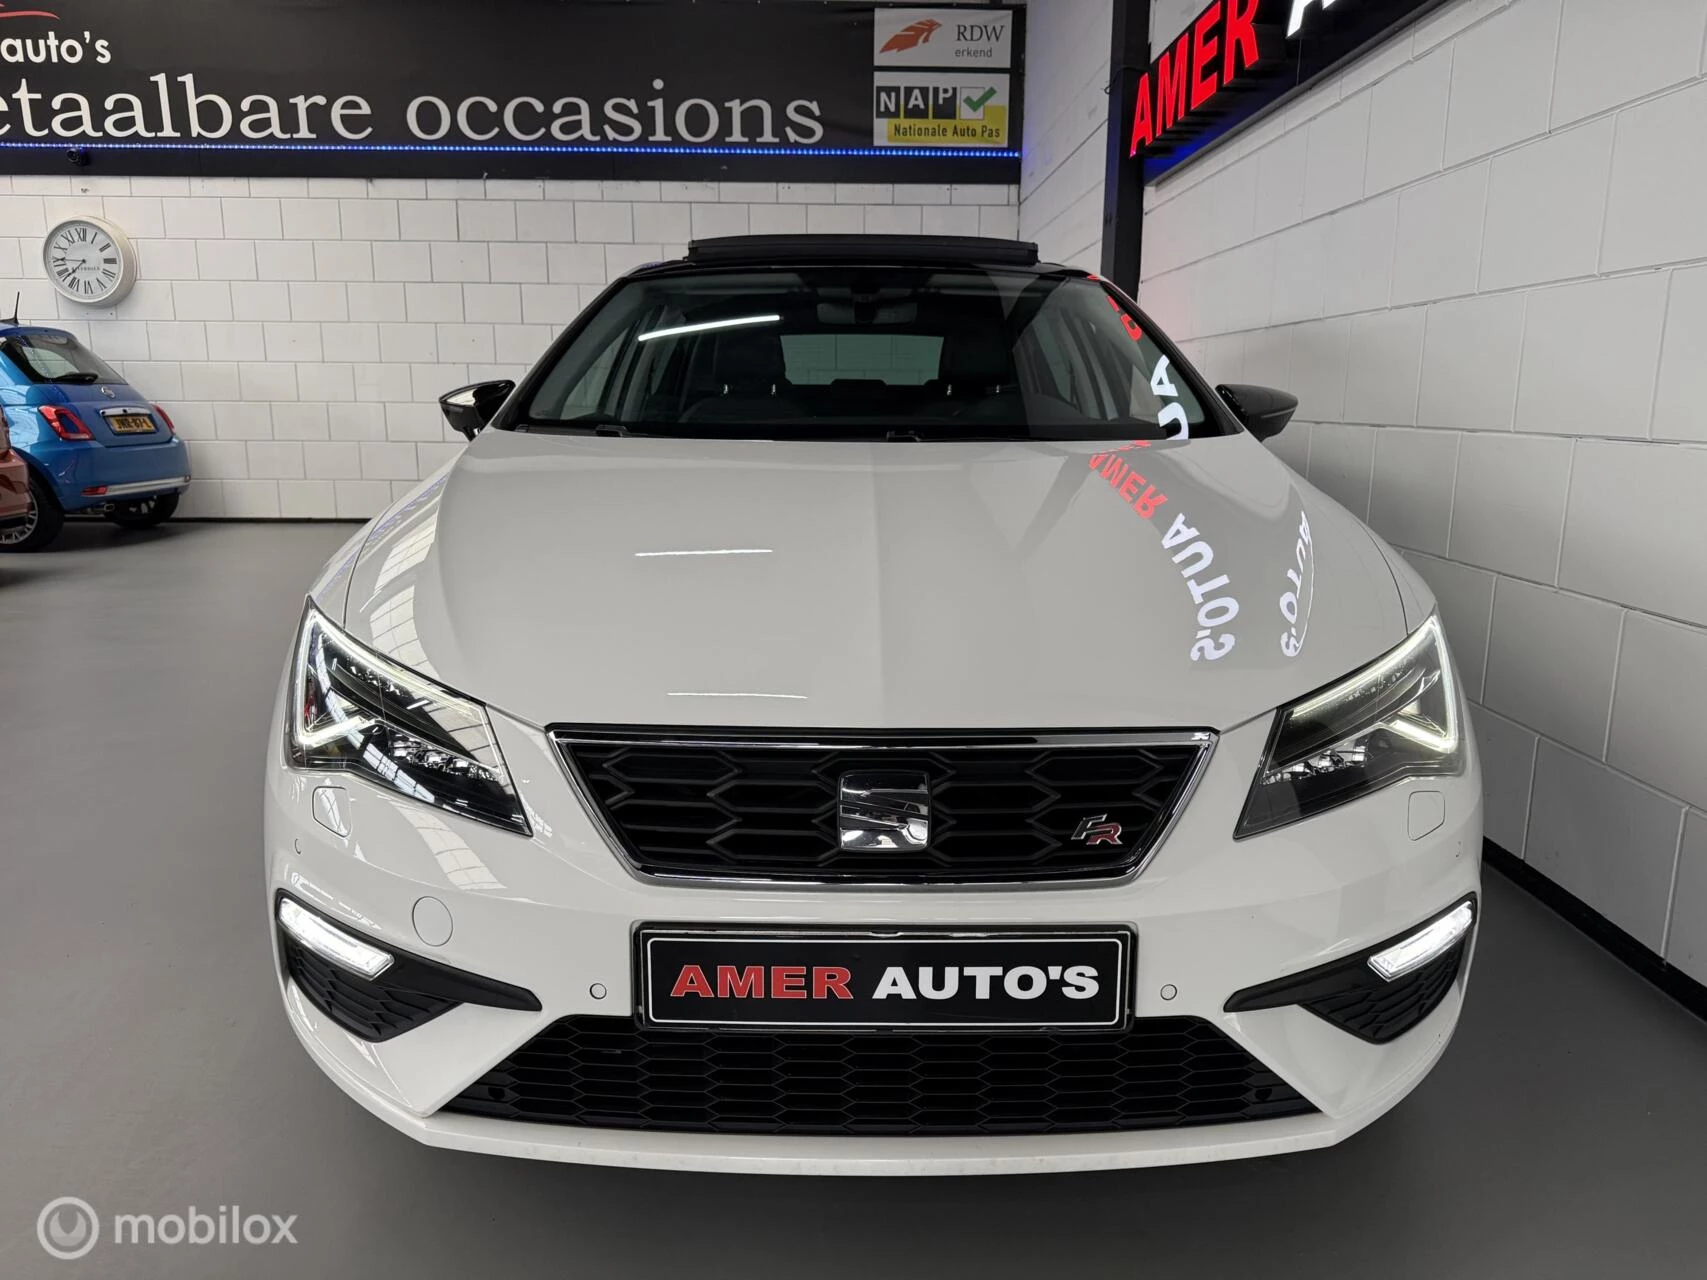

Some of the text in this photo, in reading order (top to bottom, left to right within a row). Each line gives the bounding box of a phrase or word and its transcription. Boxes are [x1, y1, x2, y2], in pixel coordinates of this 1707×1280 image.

[0, 31, 112, 64] auto's
[956, 24, 1005, 43] RDW
[954, 47, 993, 58] erkend
[1129, 0, 1260, 158] AMER
[0, 73, 824, 146] taalbare occasions
[894, 123, 1001, 138] Nationale Auto Pas
[1070, 813, 1123, 846] FR
[671, 964, 1100, 1000] AMER AUTO'S
